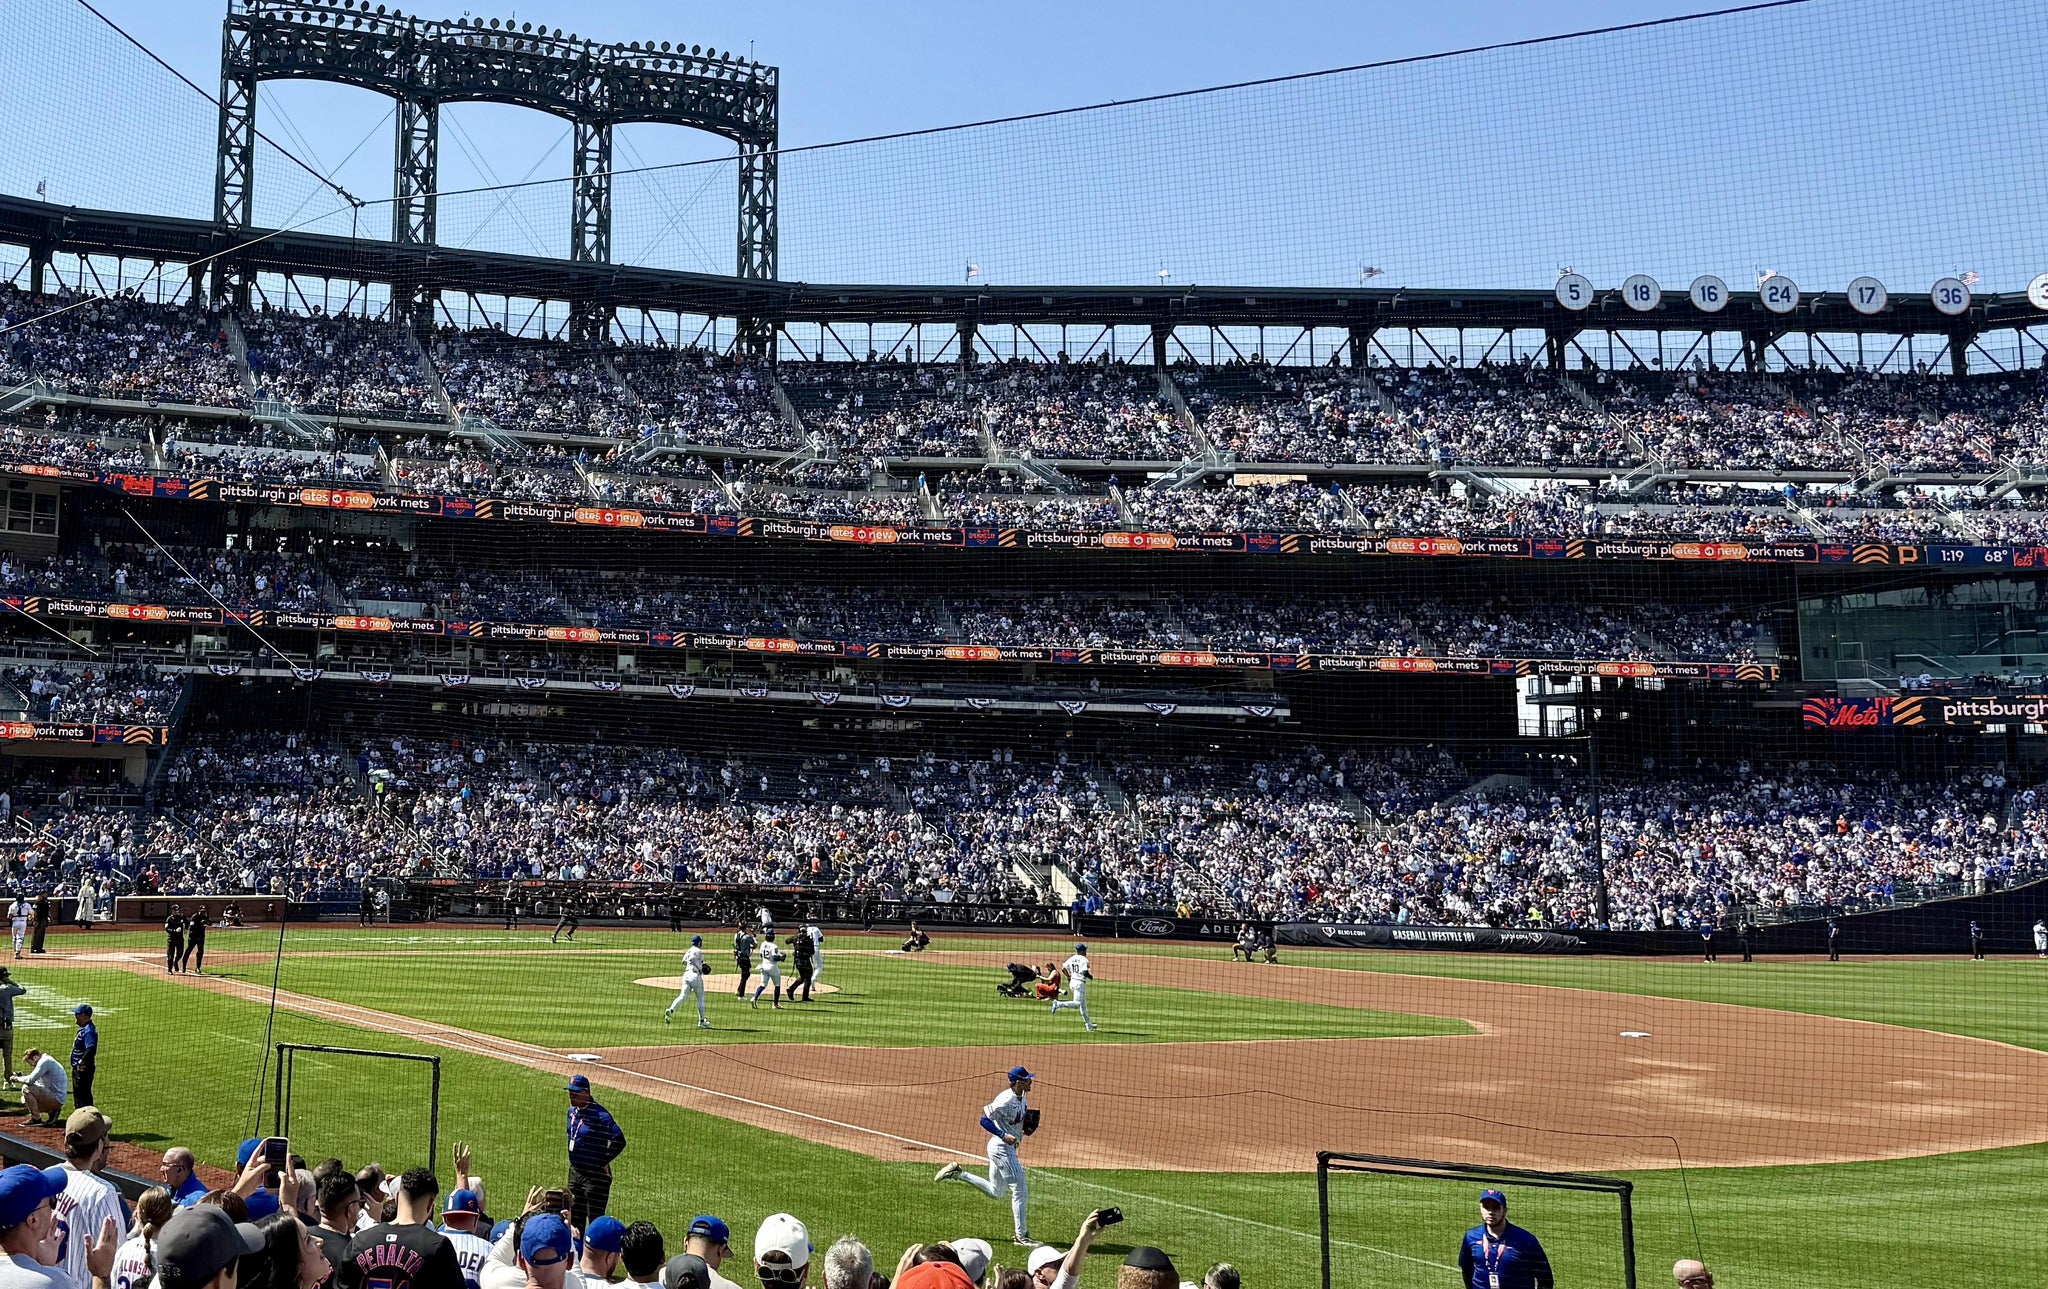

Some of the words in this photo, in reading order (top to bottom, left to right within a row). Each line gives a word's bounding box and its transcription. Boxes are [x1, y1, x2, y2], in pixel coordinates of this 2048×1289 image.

[1569, 284, 1580, 300] 5
[1633, 284, 1650, 301] 18
[1700, 286, 1718, 302] 16
[1768, 286, 1791, 302] 24
[1858, 287, 1876, 304] 17
[1940, 288, 1962, 304] 36
[288, 490, 328, 504] pirates
[346, 496, 369, 504] new
[372, 495, 397, 510] york
[400, 498, 429, 509] mets
[504, 505, 560, 520] pittsburgh
[565, 510, 600, 522] pirates
[616, 514, 638, 522] new
[642, 514, 665, 526] york
[668, 516, 695, 526] mets
[763, 523, 816, 537] pittsburgh
[820, 527, 854, 540] pirates
[868, 532, 892, 540] new
[896, 530, 919, 544] york
[923, 531, 952, 541] mets
[1027, 533, 1087, 548] pittsburgh
[1091, 534, 1130, 548] pirates
[1146, 536, 1171, 545] new
[1174, 534, 1200, 550] york
[1203, 536, 1232, 547] mets
[1310, 538, 1372, 553] pittsburgh
[1375, 540, 1415, 553] pirates
[1432, 542, 1456, 550] new
[1460, 541, 1484, 556] york
[1488, 542, 1518, 552] mets
[1596, 543, 1656, 558] pittsburgh
[1660, 544, 1700, 558] pirates
[1718, 547, 1742, 556] new
[1746, 546, 1770, 560] york
[1774, 547, 1804, 558] mets
[1941, 550, 1964, 562] 1:19
[1984, 550, 2008, 562] 68°
[48, 602, 96, 614] pittsburgh
[166, 608, 186, 620] york
[188, 610, 212, 619] mets
[391, 619, 410, 631] york
[412, 621, 434, 630] mets
[491, 626, 536, 636] pittsburgh
[598, 631, 616, 642] york
[618, 632, 640, 641] mets
[694, 636, 736, 648] pittsburgh
[796, 641, 813, 652] york
[815, 642, 836, 652] mets
[888, 646, 933, 658] pittsburgh
[998, 648, 1018, 660] york
[1020, 650, 1042, 659] mets
[1100, 652, 1148, 664] pittsburgh
[1215, 654, 1234, 666] york
[1236, 656, 1260, 664] mets
[1320, 658, 1366, 670] pittsburgh
[1434, 662, 1454, 673] york
[1456, 662, 1479, 671] mets
[1538, 662, 1585, 675] pittsburgh
[1654, 666, 1673, 678] york
[1676, 666, 1698, 676] mets
[1830, 702, 1878, 726] Mets
[34, 724, 55, 738] york
[58, 726, 84, 736] mets
[1139, 920, 1167, 932] Ford
[1392, 930, 1428, 940] BASEBALL
[1428, 931, 1463, 942] LIFESTYLE
[1463, 932, 1475, 942] 101
[356, 1244, 424, 1278] PERALTA
